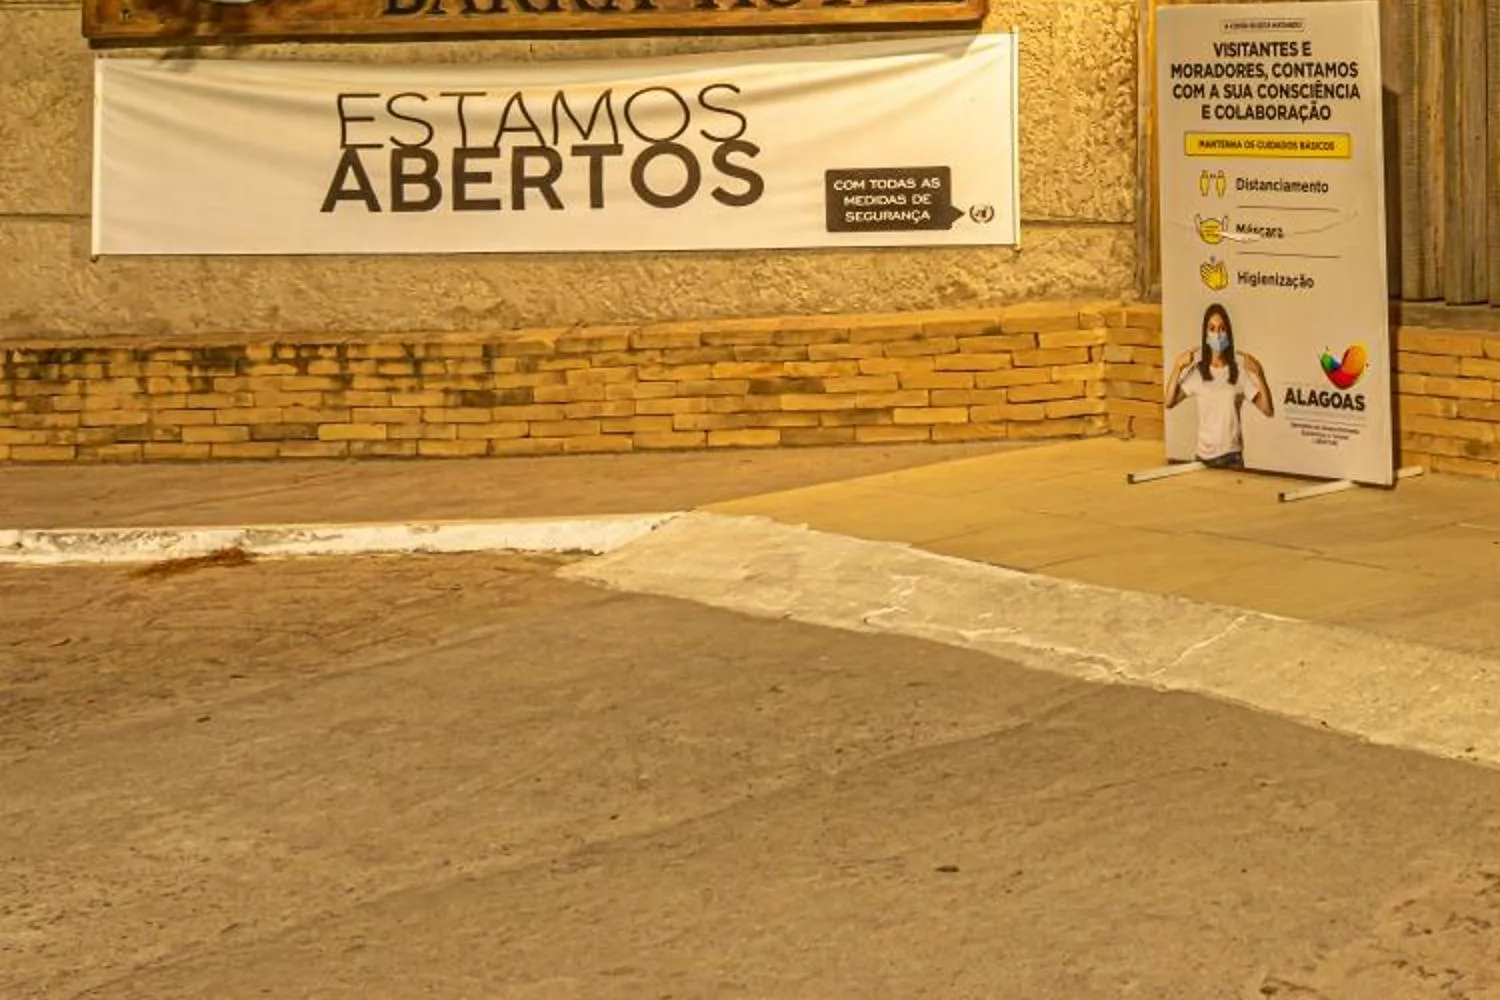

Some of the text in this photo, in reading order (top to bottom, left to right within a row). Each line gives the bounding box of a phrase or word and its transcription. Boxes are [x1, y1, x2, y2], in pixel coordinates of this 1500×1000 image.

[1213, 41, 1312, 57] VISITANTES E
[1171, 62, 1359, 81] MORADORES, CONTAMOS
[1173, 80, 1360, 100] COM A SUA CONSCIÊNCIA
[337, 83, 748, 150] ESTAMOS
[1202, 100, 1331, 124] E COLABORAÇÃO
[319, 139, 765, 213] ABERTOS
[834, 177, 941, 191] COM TODAS AS
[1235, 177, 1329, 193] Distanciamento
[843, 193, 932, 206] MEDIDAS DE
[845, 210, 931, 224] SEGURANÇA
[1237, 271, 1315, 289] Higienização
[1283, 387, 1365, 412] ALAGOAS
